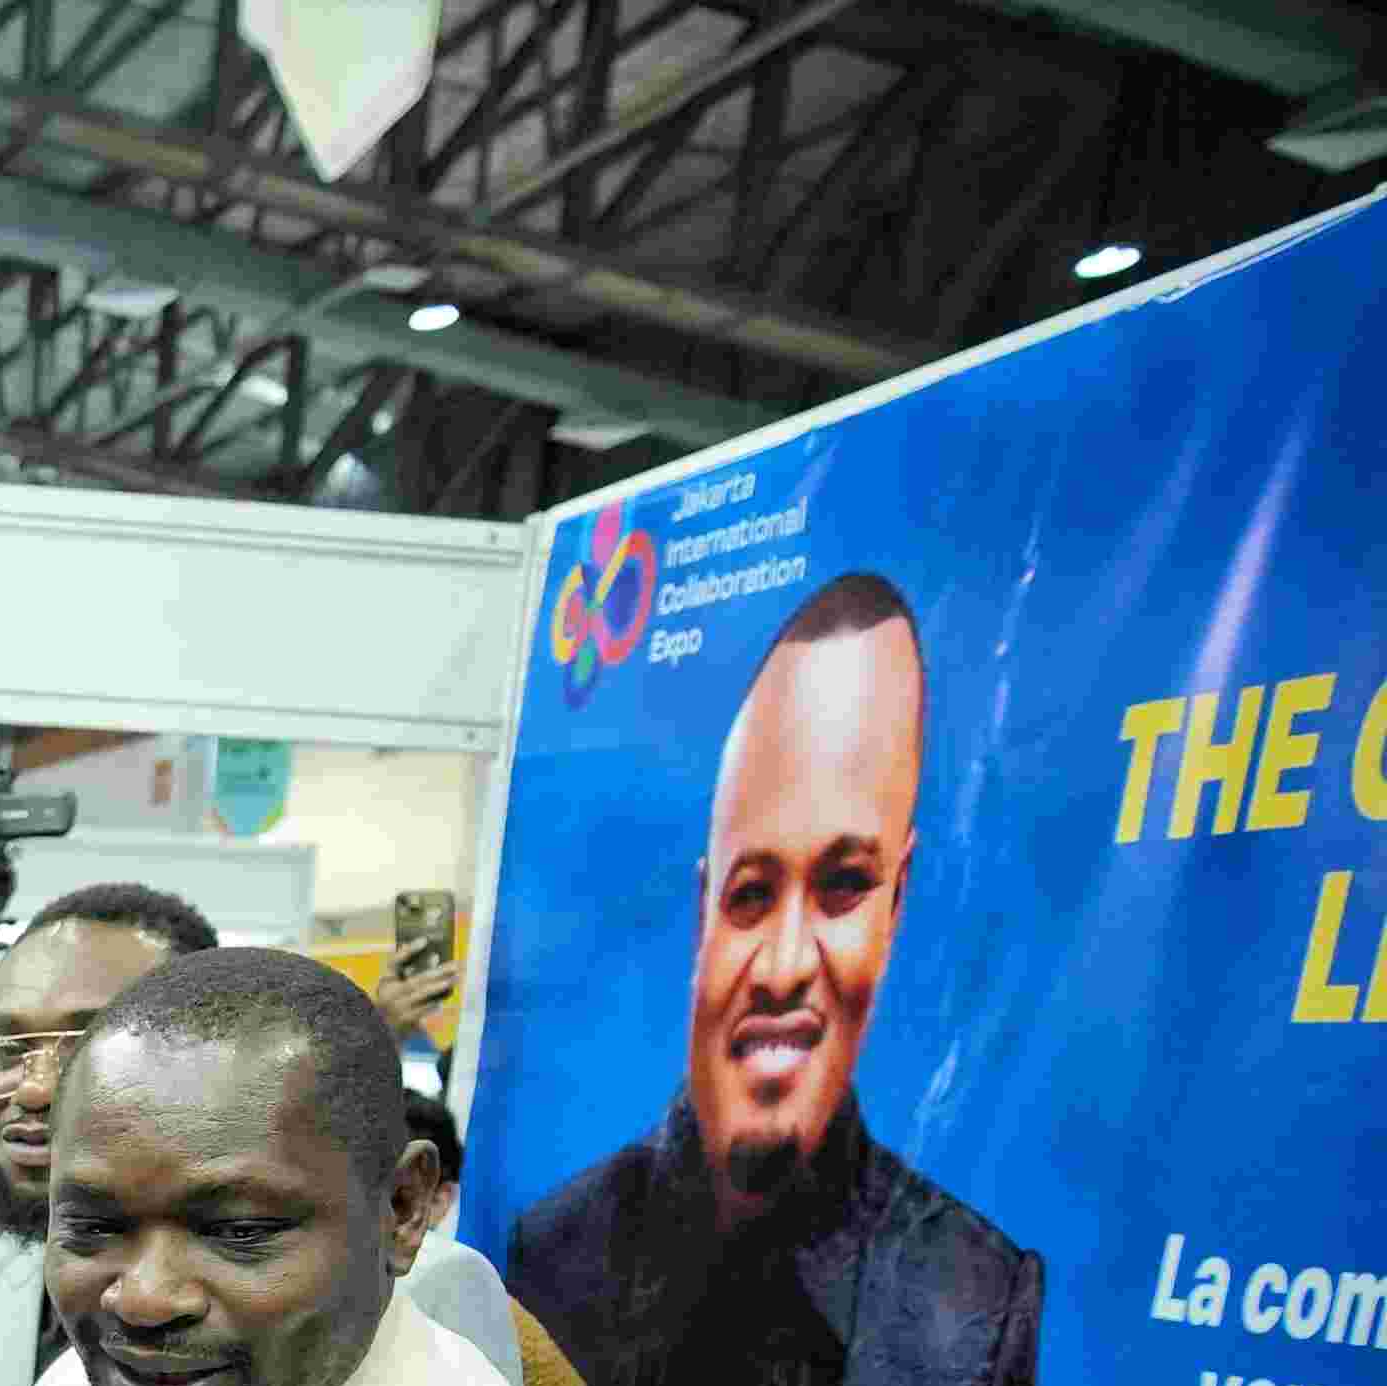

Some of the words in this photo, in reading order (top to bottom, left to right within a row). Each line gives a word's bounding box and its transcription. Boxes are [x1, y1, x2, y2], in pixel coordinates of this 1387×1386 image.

[672, 472, 756, 521] Jakarta
[666, 496, 808, 568] International
[658, 553, 807, 616] Collaboration
[649, 628, 703, 667] Expo
[1114, 671, 1338, 845] THE
[1150, 1232, 1231, 1327] La
